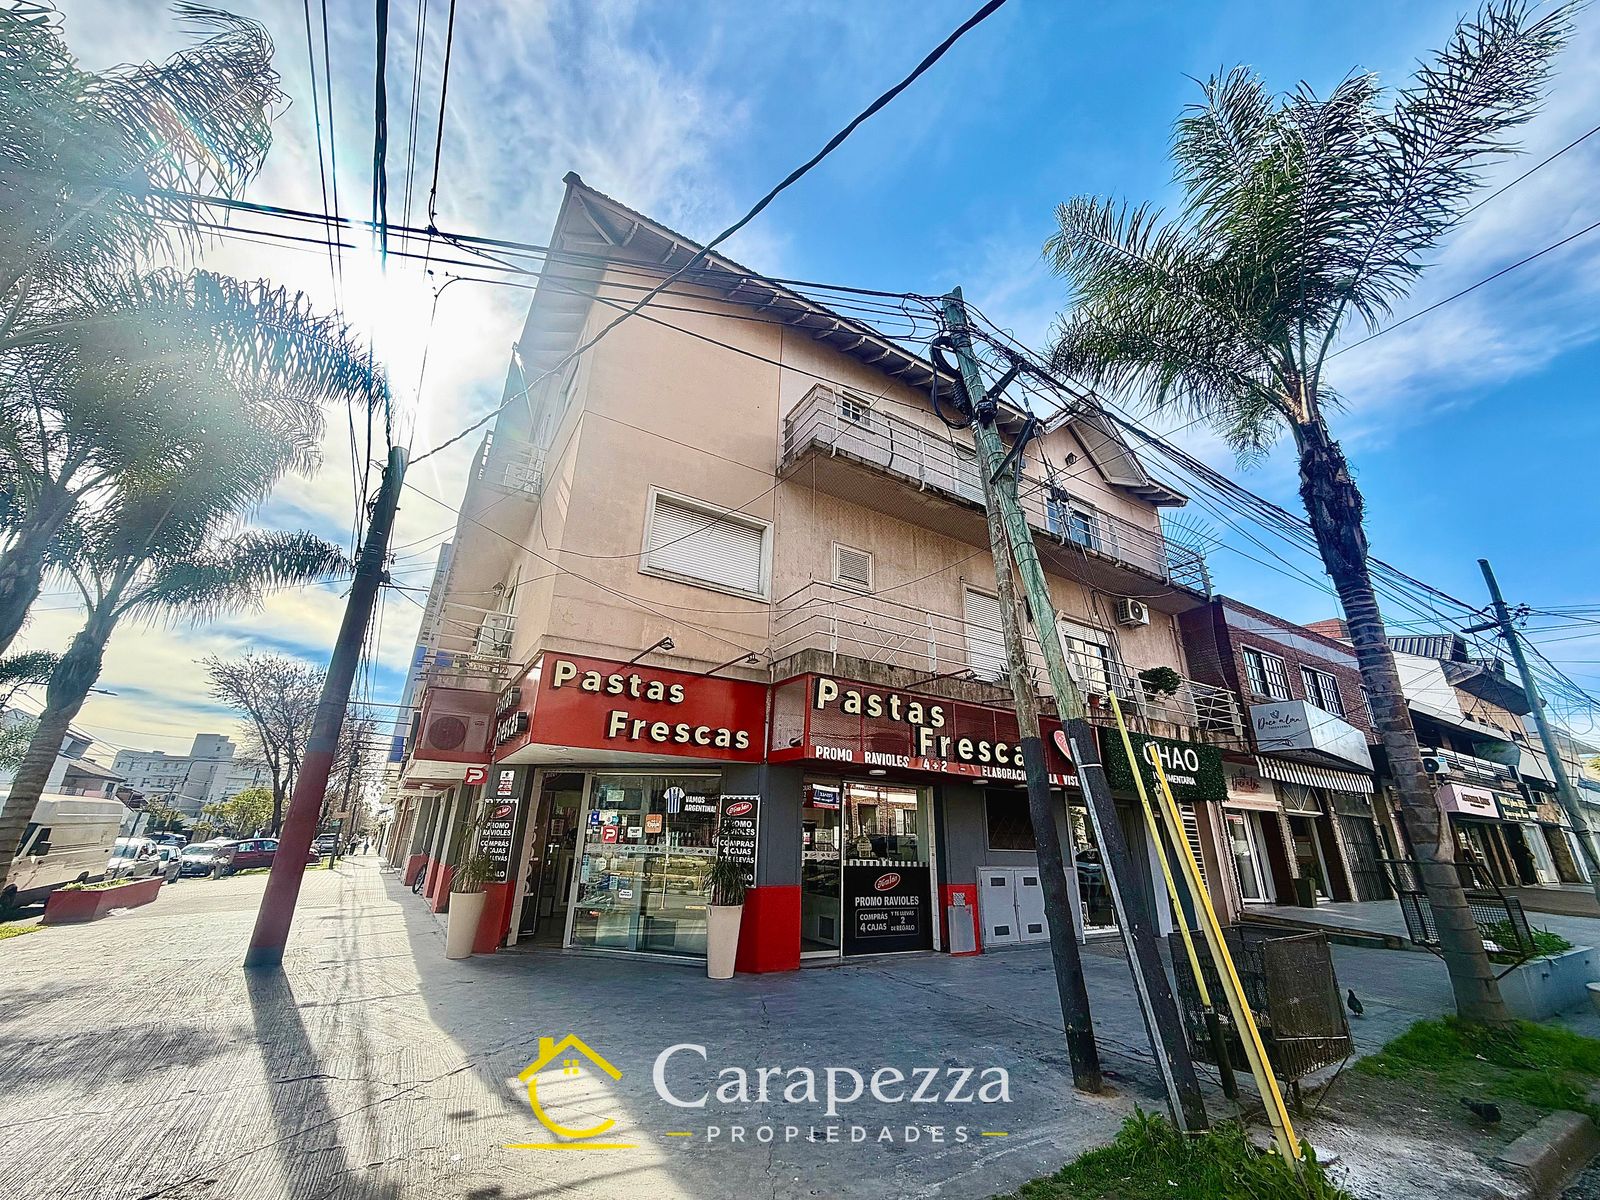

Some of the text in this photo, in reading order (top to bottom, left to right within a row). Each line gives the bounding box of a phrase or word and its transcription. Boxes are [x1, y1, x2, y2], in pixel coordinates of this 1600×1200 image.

[553, 660, 685, 703] Pastas
[817, 678, 945, 728] Pastas
[609, 710, 749, 749] Frescas
[919, 726, 1025, 767] Fresca
[815, 745, 853, 762] PROMO
[864, 751, 910, 768] RAVIOLES
[685, 795, 706, 804] VAMOS
[684, 804, 717, 813] ARGENTINA!
[855, 896, 919, 907] PROMO RAVIOLES
[860, 912, 888, 921] COMPRÁS
[900, 916, 906, 924] 2
[860, 922, 887, 933] 4 CAJAS
